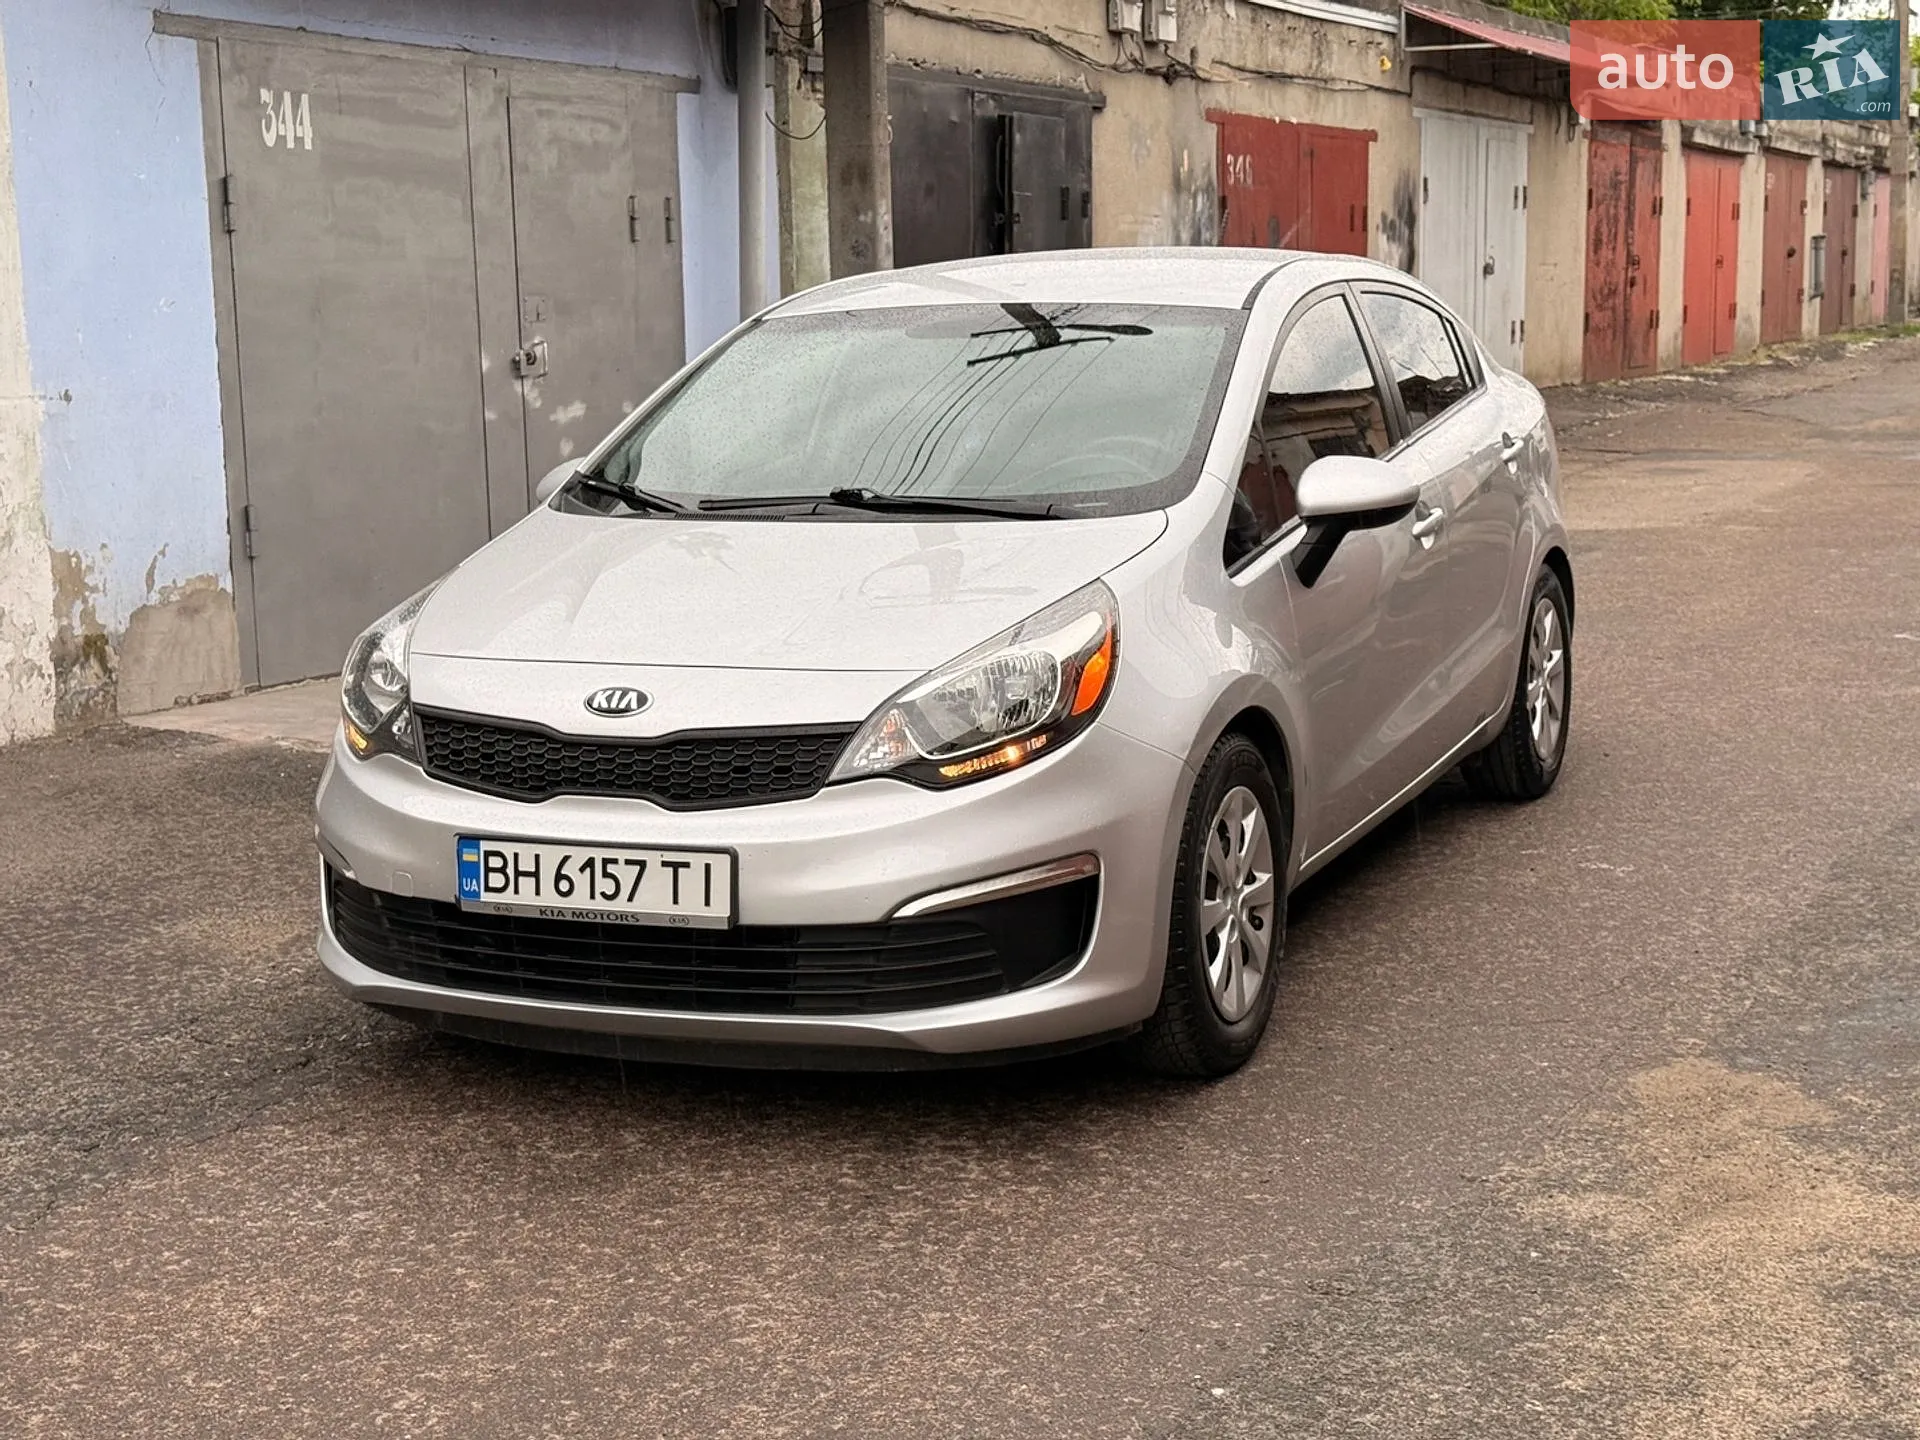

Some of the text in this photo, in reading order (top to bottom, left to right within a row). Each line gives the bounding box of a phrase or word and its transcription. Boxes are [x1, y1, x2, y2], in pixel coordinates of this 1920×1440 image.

[260, 88, 313, 150] 344
[592, 690, 638, 710] KIA
[463, 877, 480, 892] UA
[483, 849, 712, 907] BH 6157 TI
[539, 908, 640, 923] KIA MOTORS
